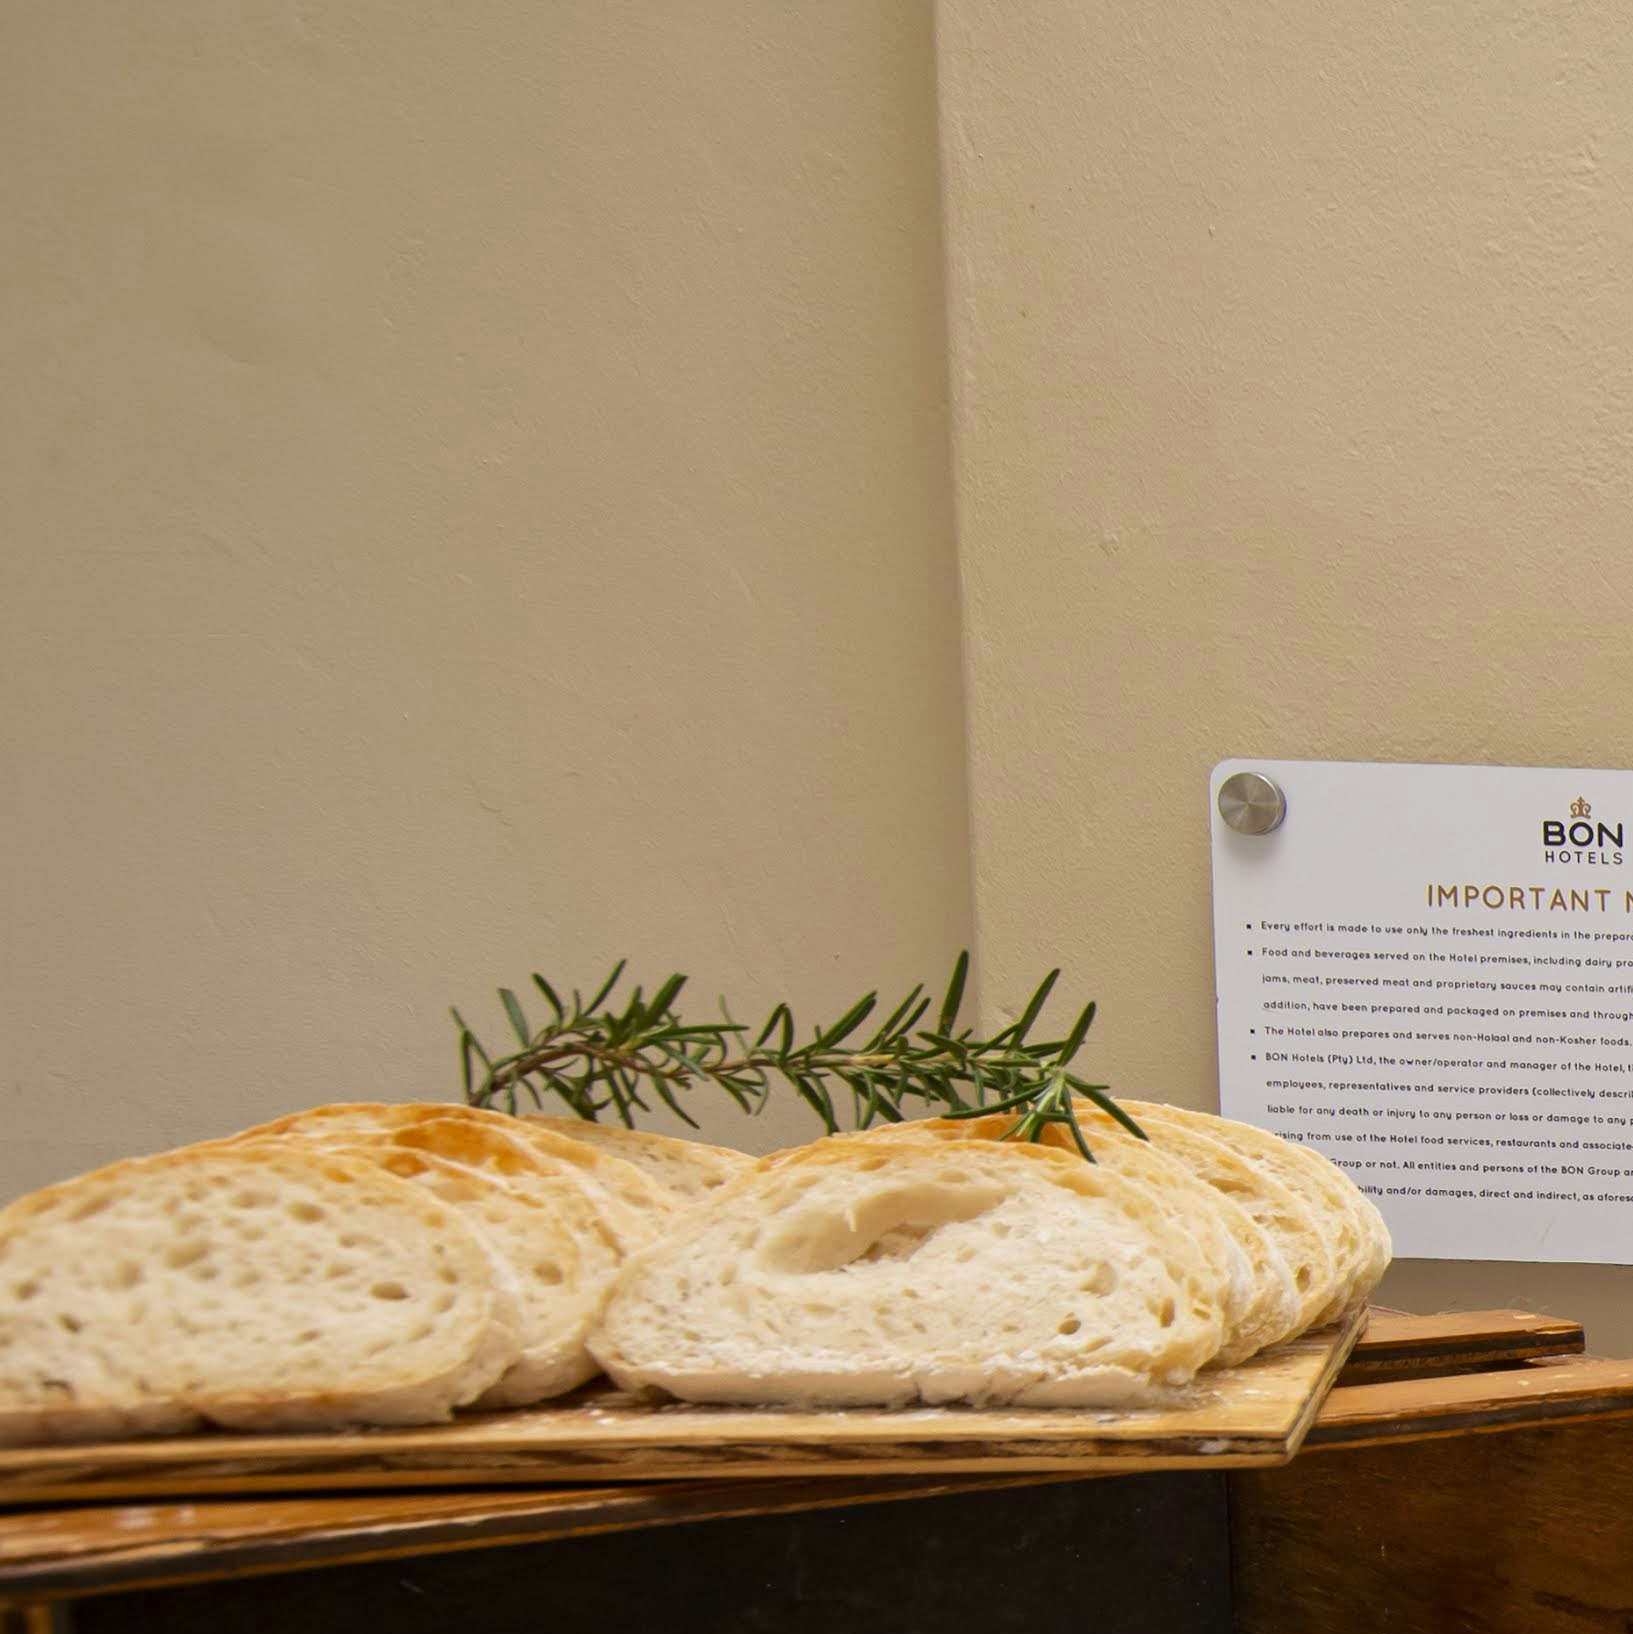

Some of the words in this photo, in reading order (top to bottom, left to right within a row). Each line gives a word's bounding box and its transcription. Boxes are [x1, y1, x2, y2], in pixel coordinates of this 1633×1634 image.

[1542, 820, 1624, 848] BON
[1544, 850, 1623, 865] HOTELS
[1426, 884, 1612, 912] IMPORTANT
[1260, 919, 1290, 933] Every
[1292, 921, 1322, 932] effort
[1325, 922, 1335, 932] is
[1336, 923, 1368, 933] made
[1369, 923, 1382, 934] to
[1383, 925, 1403, 934] use
[1405, 925, 1428, 937] only
[1430, 925, 1448, 936] the
[1451, 926, 1494, 937] freshest
[1496, 927, 1557, 940] ingredients
[1559, 930, 1570, 939] in
[1572, 929, 1590, 940] the
[1260, 946, 1288, 957] Food
[1290, 947, 1311, 958] and
[1313, 948, 1370, 961] beverages
[1372, 950, 1409, 961] served
[1411, 953, 1425, 961] on
[1427, 951, 1445, 962] the
[1448, 952, 1477, 963] Hotel
[1478, 954, 1531, 966] premises,
[1532, 954, 1581, 968] including
[1583, 956, 1612, 969] dairy
[1261, 973, 1290, 984] jams,
[1291, 974, 1322, 985] meat,
[1324, 976, 1379, 986] preserved
[1381, 977, 1409, 987] meat
[1411, 978, 1432, 988] and
[1435, 979, 1496, 992] proprietary
[1499, 981, 1536, 991] sauces
[1538, 983, 1561, 994] may
[1564, 982, 1604, 993] contain
[1262, 999, 1310, 1012] addition,
[1311, 1000, 1338, 1011] have
[1340, 1001, 1367, 1012] been
[1369, 1003, 1420, 1014] prepared
[1422, 1004, 1443, 1015] and
[1445, 1005, 1499, 1018] packaged
[1501, 1008, 1515, 1017] on
[1517, 1008, 1567, 1019] premises
[1568, 1009, 1589, 1019] and
[1263, 1024, 1283, 1036] The
[1286, 1026, 1315, 1037] Hotel
[1316, 1027, 1338, 1038] also
[1340, 1029, 1389, 1040] prepares
[1391, 1030, 1412, 1040] and
[1415, 1031, 1450, 1041] serves
[1452, 1032, 1509, 1043] non-Halaal
[1511, 1033, 1532, 1044] and
[1534, 1034, 1596, 1045] non-Kosher
[1599, 1035, 1632, 1047] foods.
[1264, 1051, 1288, 1062] BON
[1290, 1052, 1324, 1063] Hotels
[1326, 1053, 1353, 1066] (Pty)
[1355, 1054, 1376, 1066] Ltd,
[1377, 1055, 1396, 1065] the
[1397, 1057, 1483, 1069] owner/operator
[1485, 1059, 1506, 1069] and
[1508, 1061, 1557, 1072] manager
[1559, 1061, 1571, 1071] of
[1573, 1061, 1591, 1072] the
[1593, 1062, 1625, 1074] Hotel,
[1265, 1078, 1326, 1090] employees,
[1327, 1081, 1411, 1092] representatives
[1413, 1082, 1433, 1093] and
[1436, 1084, 1475, 1094] service
[1477, 1085, 1529, 1096] providers
[1531, 1085, 1595, 1100] (collectively
